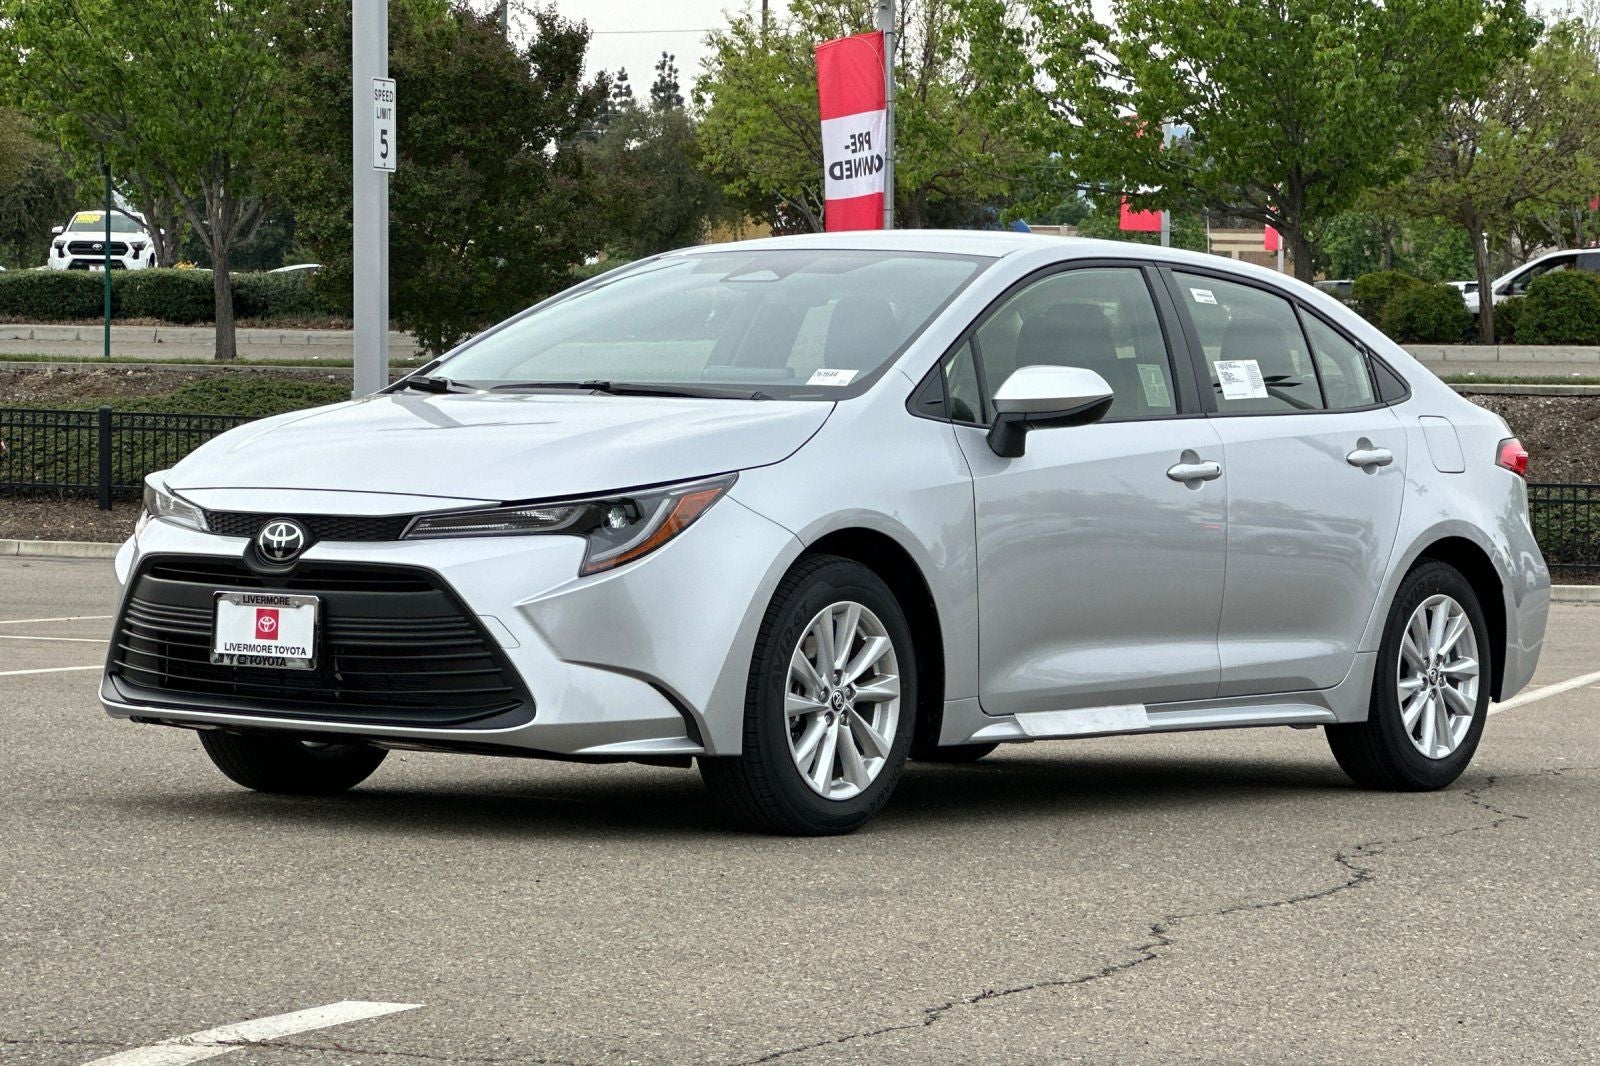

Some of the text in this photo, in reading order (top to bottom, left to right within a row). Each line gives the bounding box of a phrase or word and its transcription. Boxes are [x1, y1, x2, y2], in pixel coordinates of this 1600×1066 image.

[374, 89, 394, 102] SPEED
[376, 106, 392, 120] LIMIT
[380, 129, 389, 159] 5
[242, 594, 291, 606] LIVERMORE
[224, 642, 307, 656] LIVERMORE TOYOTA
[248, 655, 287, 667] TOYOTA
